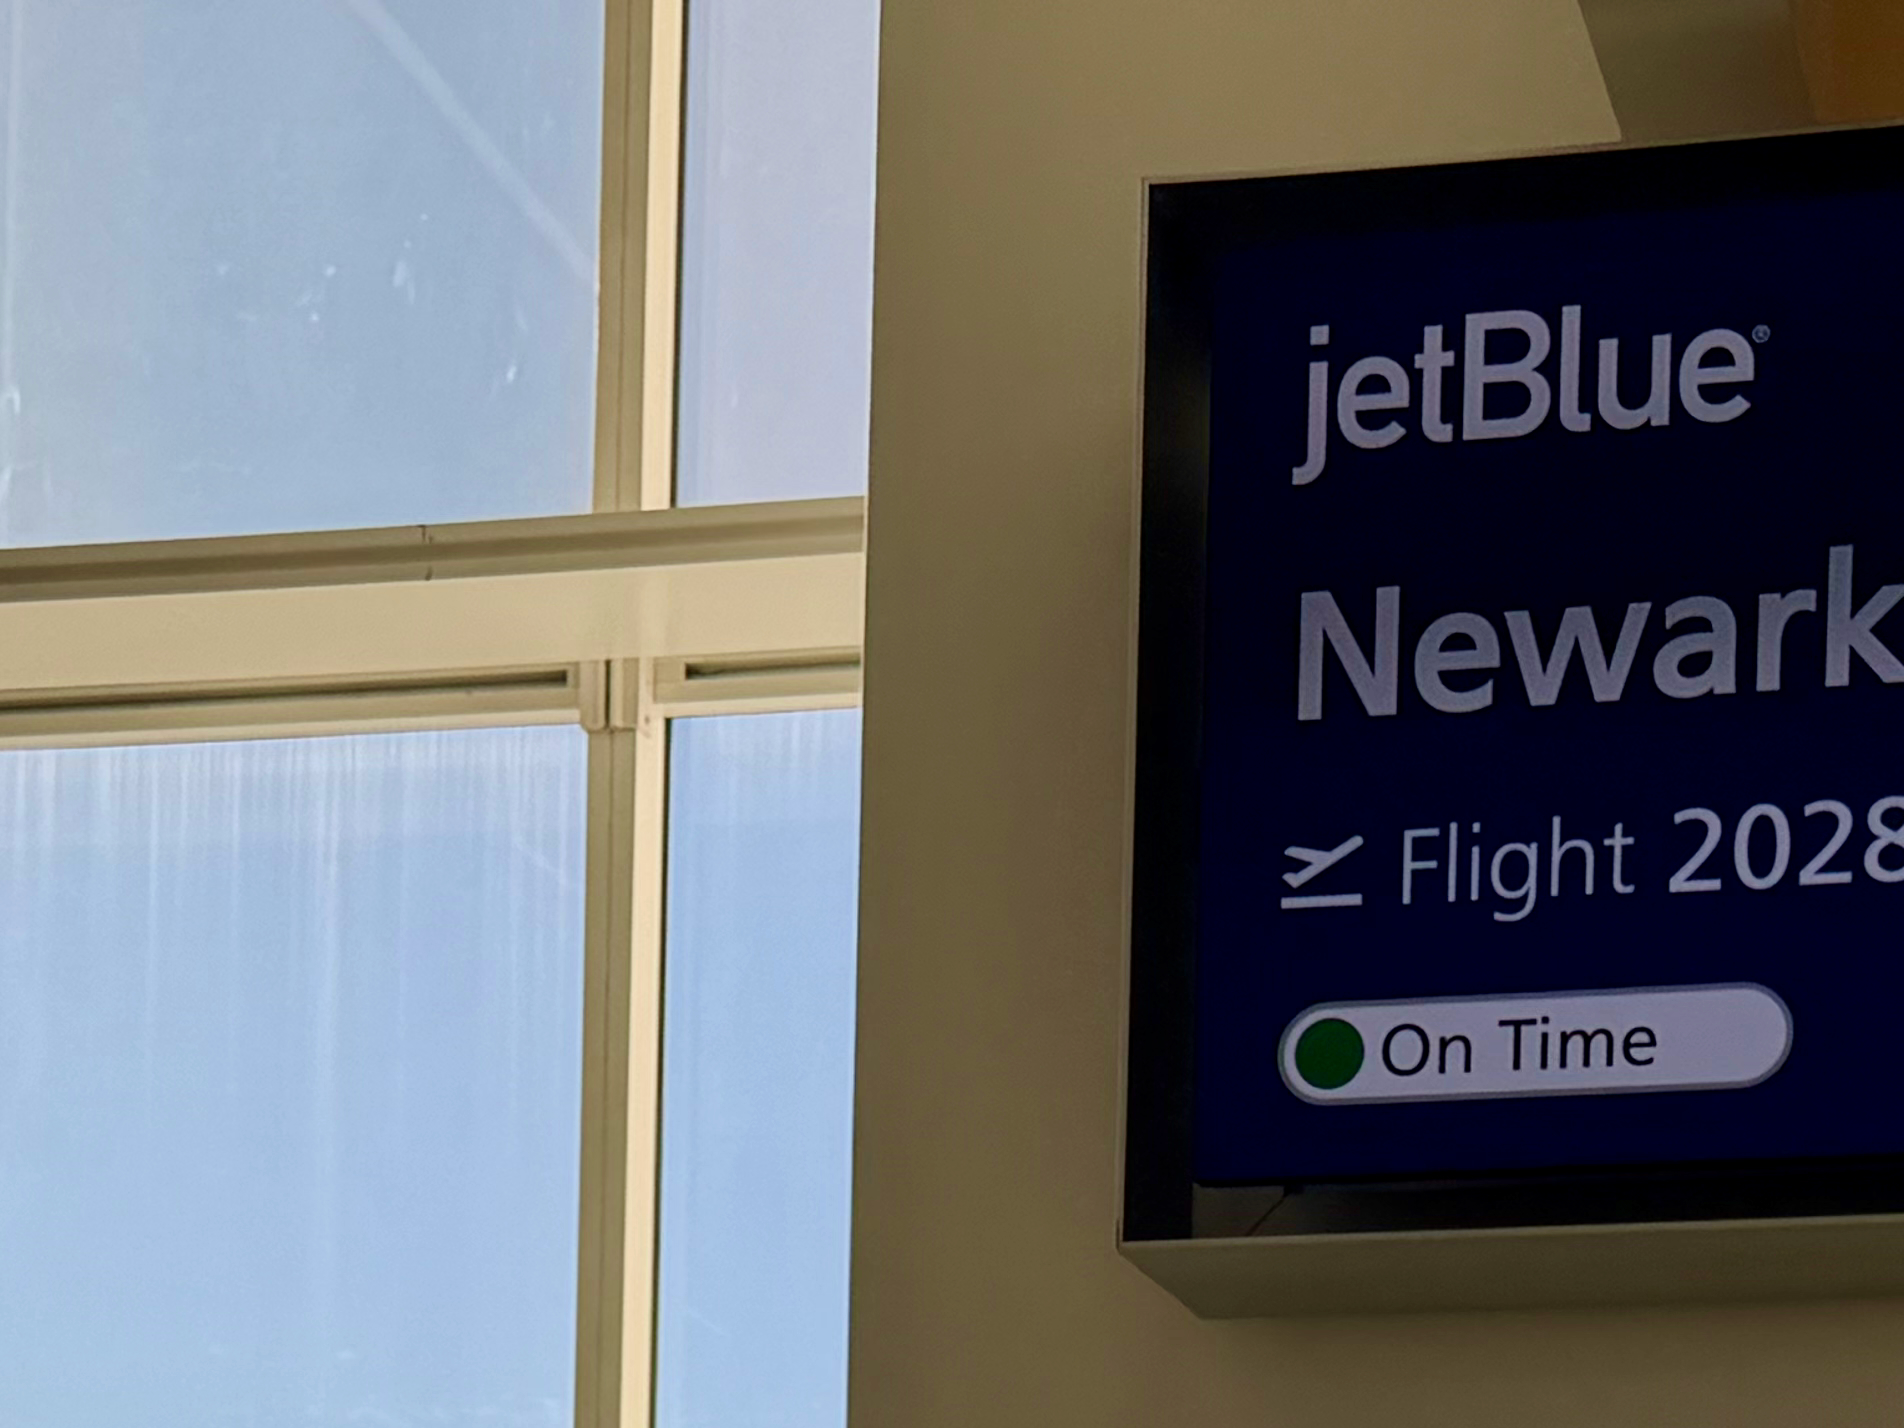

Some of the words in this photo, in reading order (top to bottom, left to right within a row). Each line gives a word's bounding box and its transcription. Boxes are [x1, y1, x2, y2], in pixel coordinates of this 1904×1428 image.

[1402, 815, 1635, 922] Flight
[1381, 1023, 1472, 1077] On
[1497, 1015, 1658, 1071] Time
